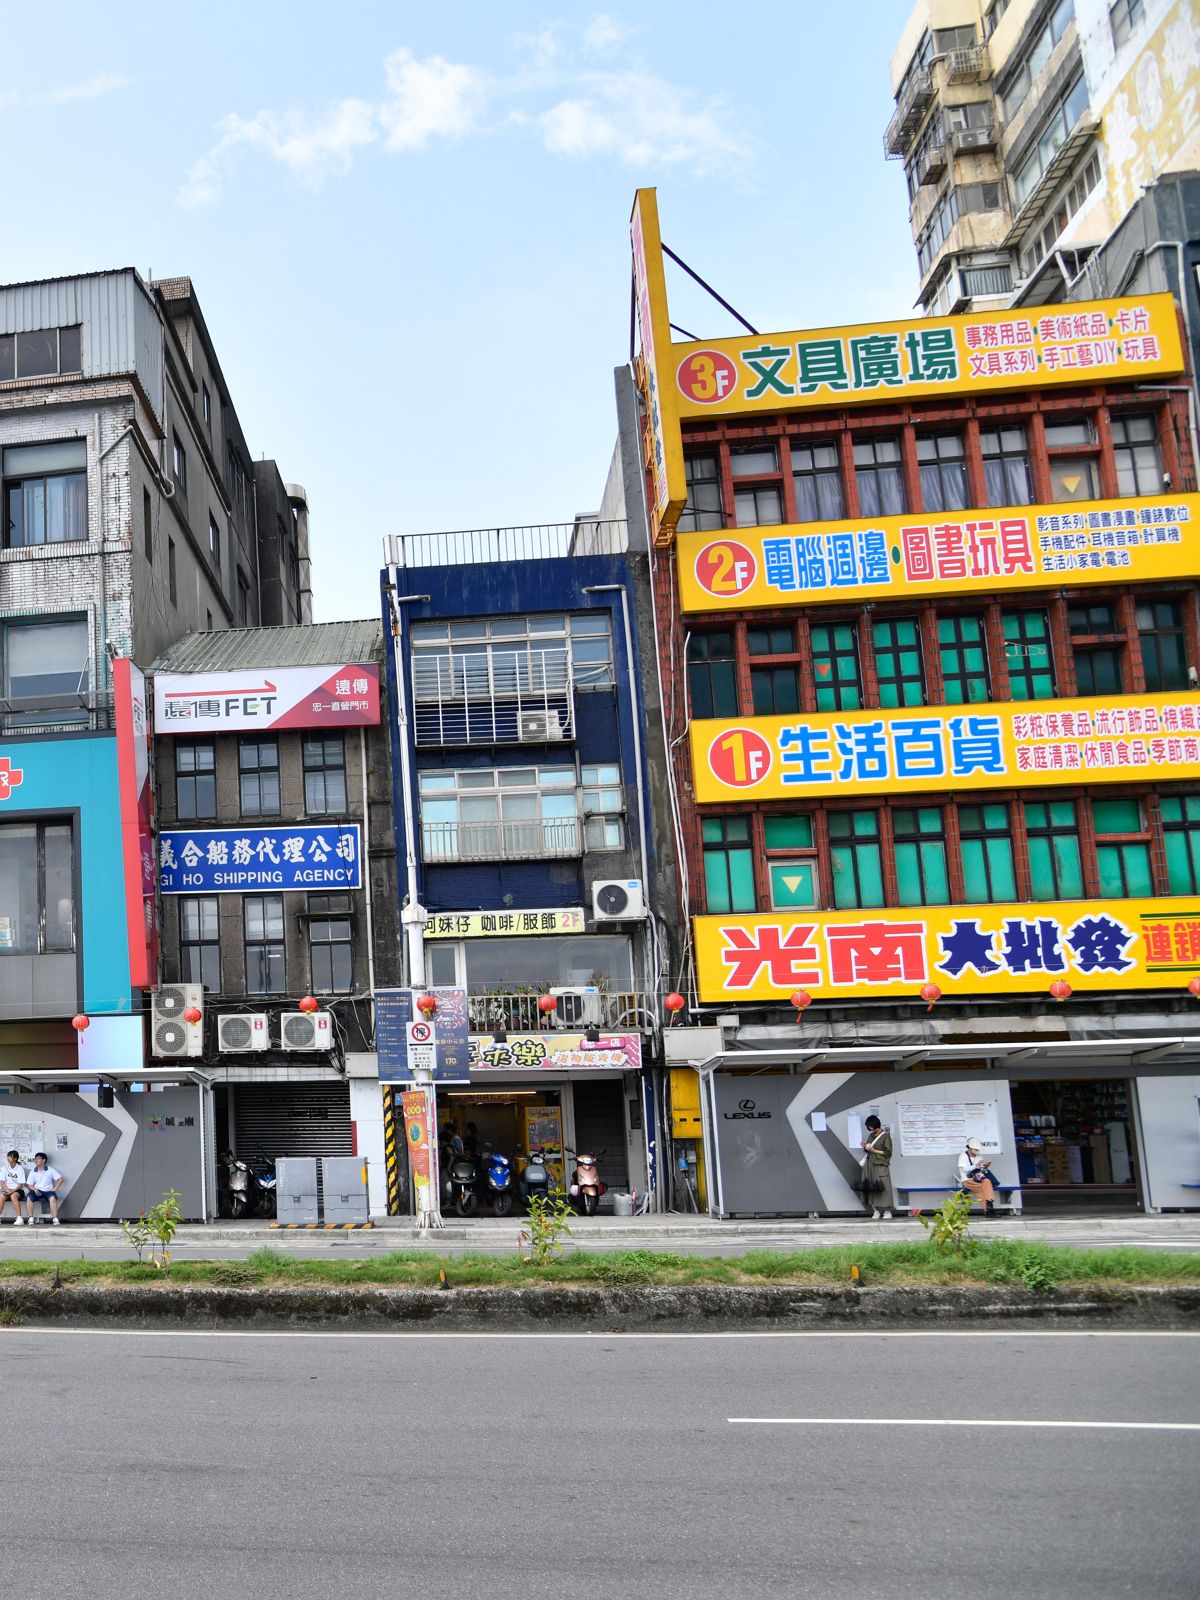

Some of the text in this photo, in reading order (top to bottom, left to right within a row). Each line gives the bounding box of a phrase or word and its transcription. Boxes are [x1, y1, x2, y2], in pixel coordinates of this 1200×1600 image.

[691, 355, 729, 399] 3F
[742, 329, 957, 398] 文具廣場
[708, 544, 749, 593] 2F
[336, 679, 368, 695] 遠傳
[225, 697, 277, 717] FET
[312, 701, 369, 712] 忠一直營門市
[722, 733, 763, 783] 1F
[779, 718, 1003, 784] 生活百貨
[160, 833, 355, 870] 義合船務代理公司
[183, 873, 203, 885] HO
[214, 871, 283, 884] SHIPPING
[294, 869, 354, 882] AGENCY
[481, 912, 556, 932] 咖啡/服飾
[562, 914, 580, 928] 2F
[445, 1057, 457, 1065] 170
